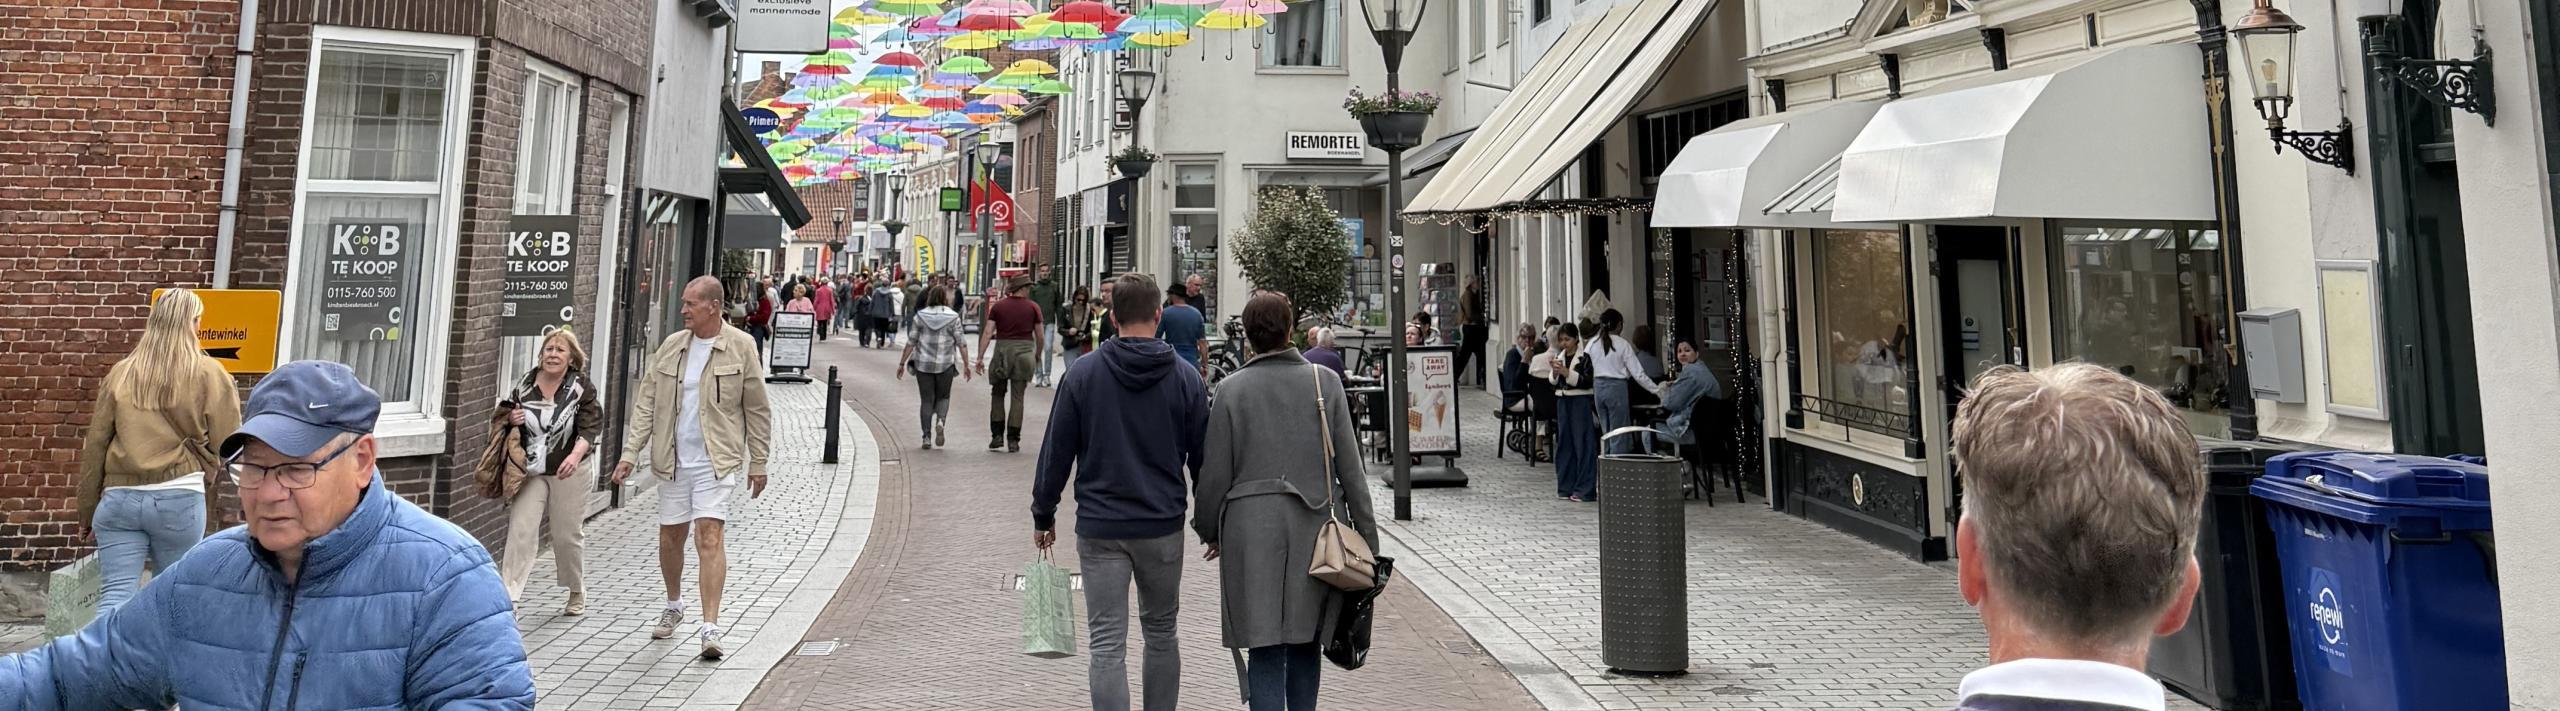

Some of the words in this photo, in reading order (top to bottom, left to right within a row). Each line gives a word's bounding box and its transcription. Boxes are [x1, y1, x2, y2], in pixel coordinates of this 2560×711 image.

[749, 7, 822, 15] mannenmode
[748, 115, 779, 127] Primera
[1291, 135, 1361, 149] REMORTEL
[331, 260, 349, 275] TE
[352, 260, 398, 275] KOOP
[506, 260, 523, 272] TE
[527, 260, 569, 273] KOOP
[549, 281, 568, 290] 500
[327, 287, 375, 298] 0115-760
[377, 287, 397, 298] 500
[197, 327, 248, 340] entewinkel
[2310, 602, 2344, 630] renewi
